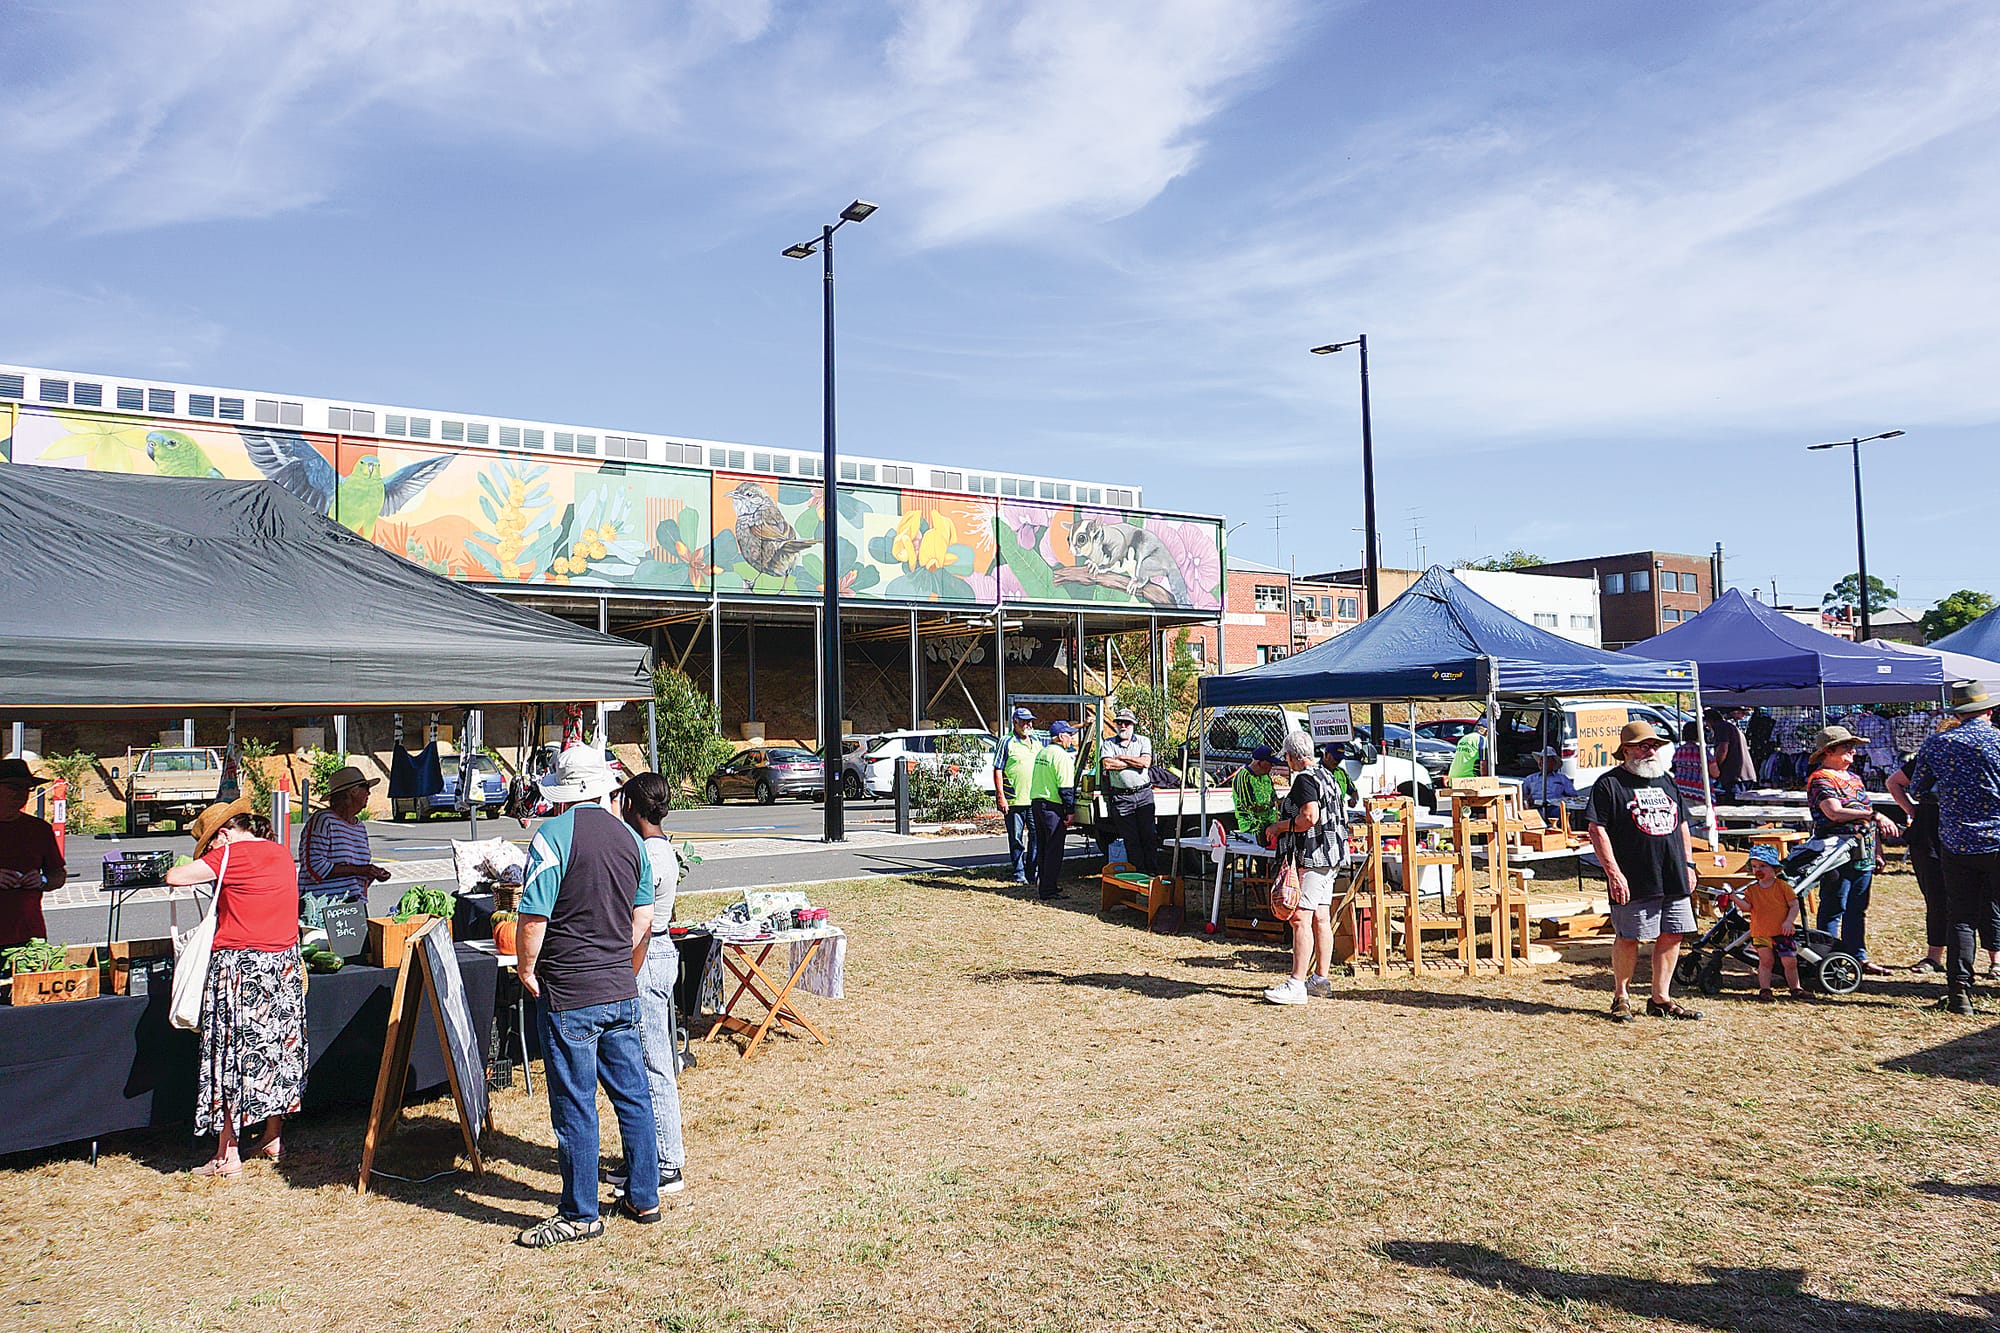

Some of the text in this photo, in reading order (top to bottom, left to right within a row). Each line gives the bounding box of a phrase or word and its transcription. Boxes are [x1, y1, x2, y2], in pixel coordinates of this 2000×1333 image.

[1606, 725, 1622, 737] SHE
[1641, 797, 1667, 805] MUSIC
[38, 979, 77, 995] LCG
